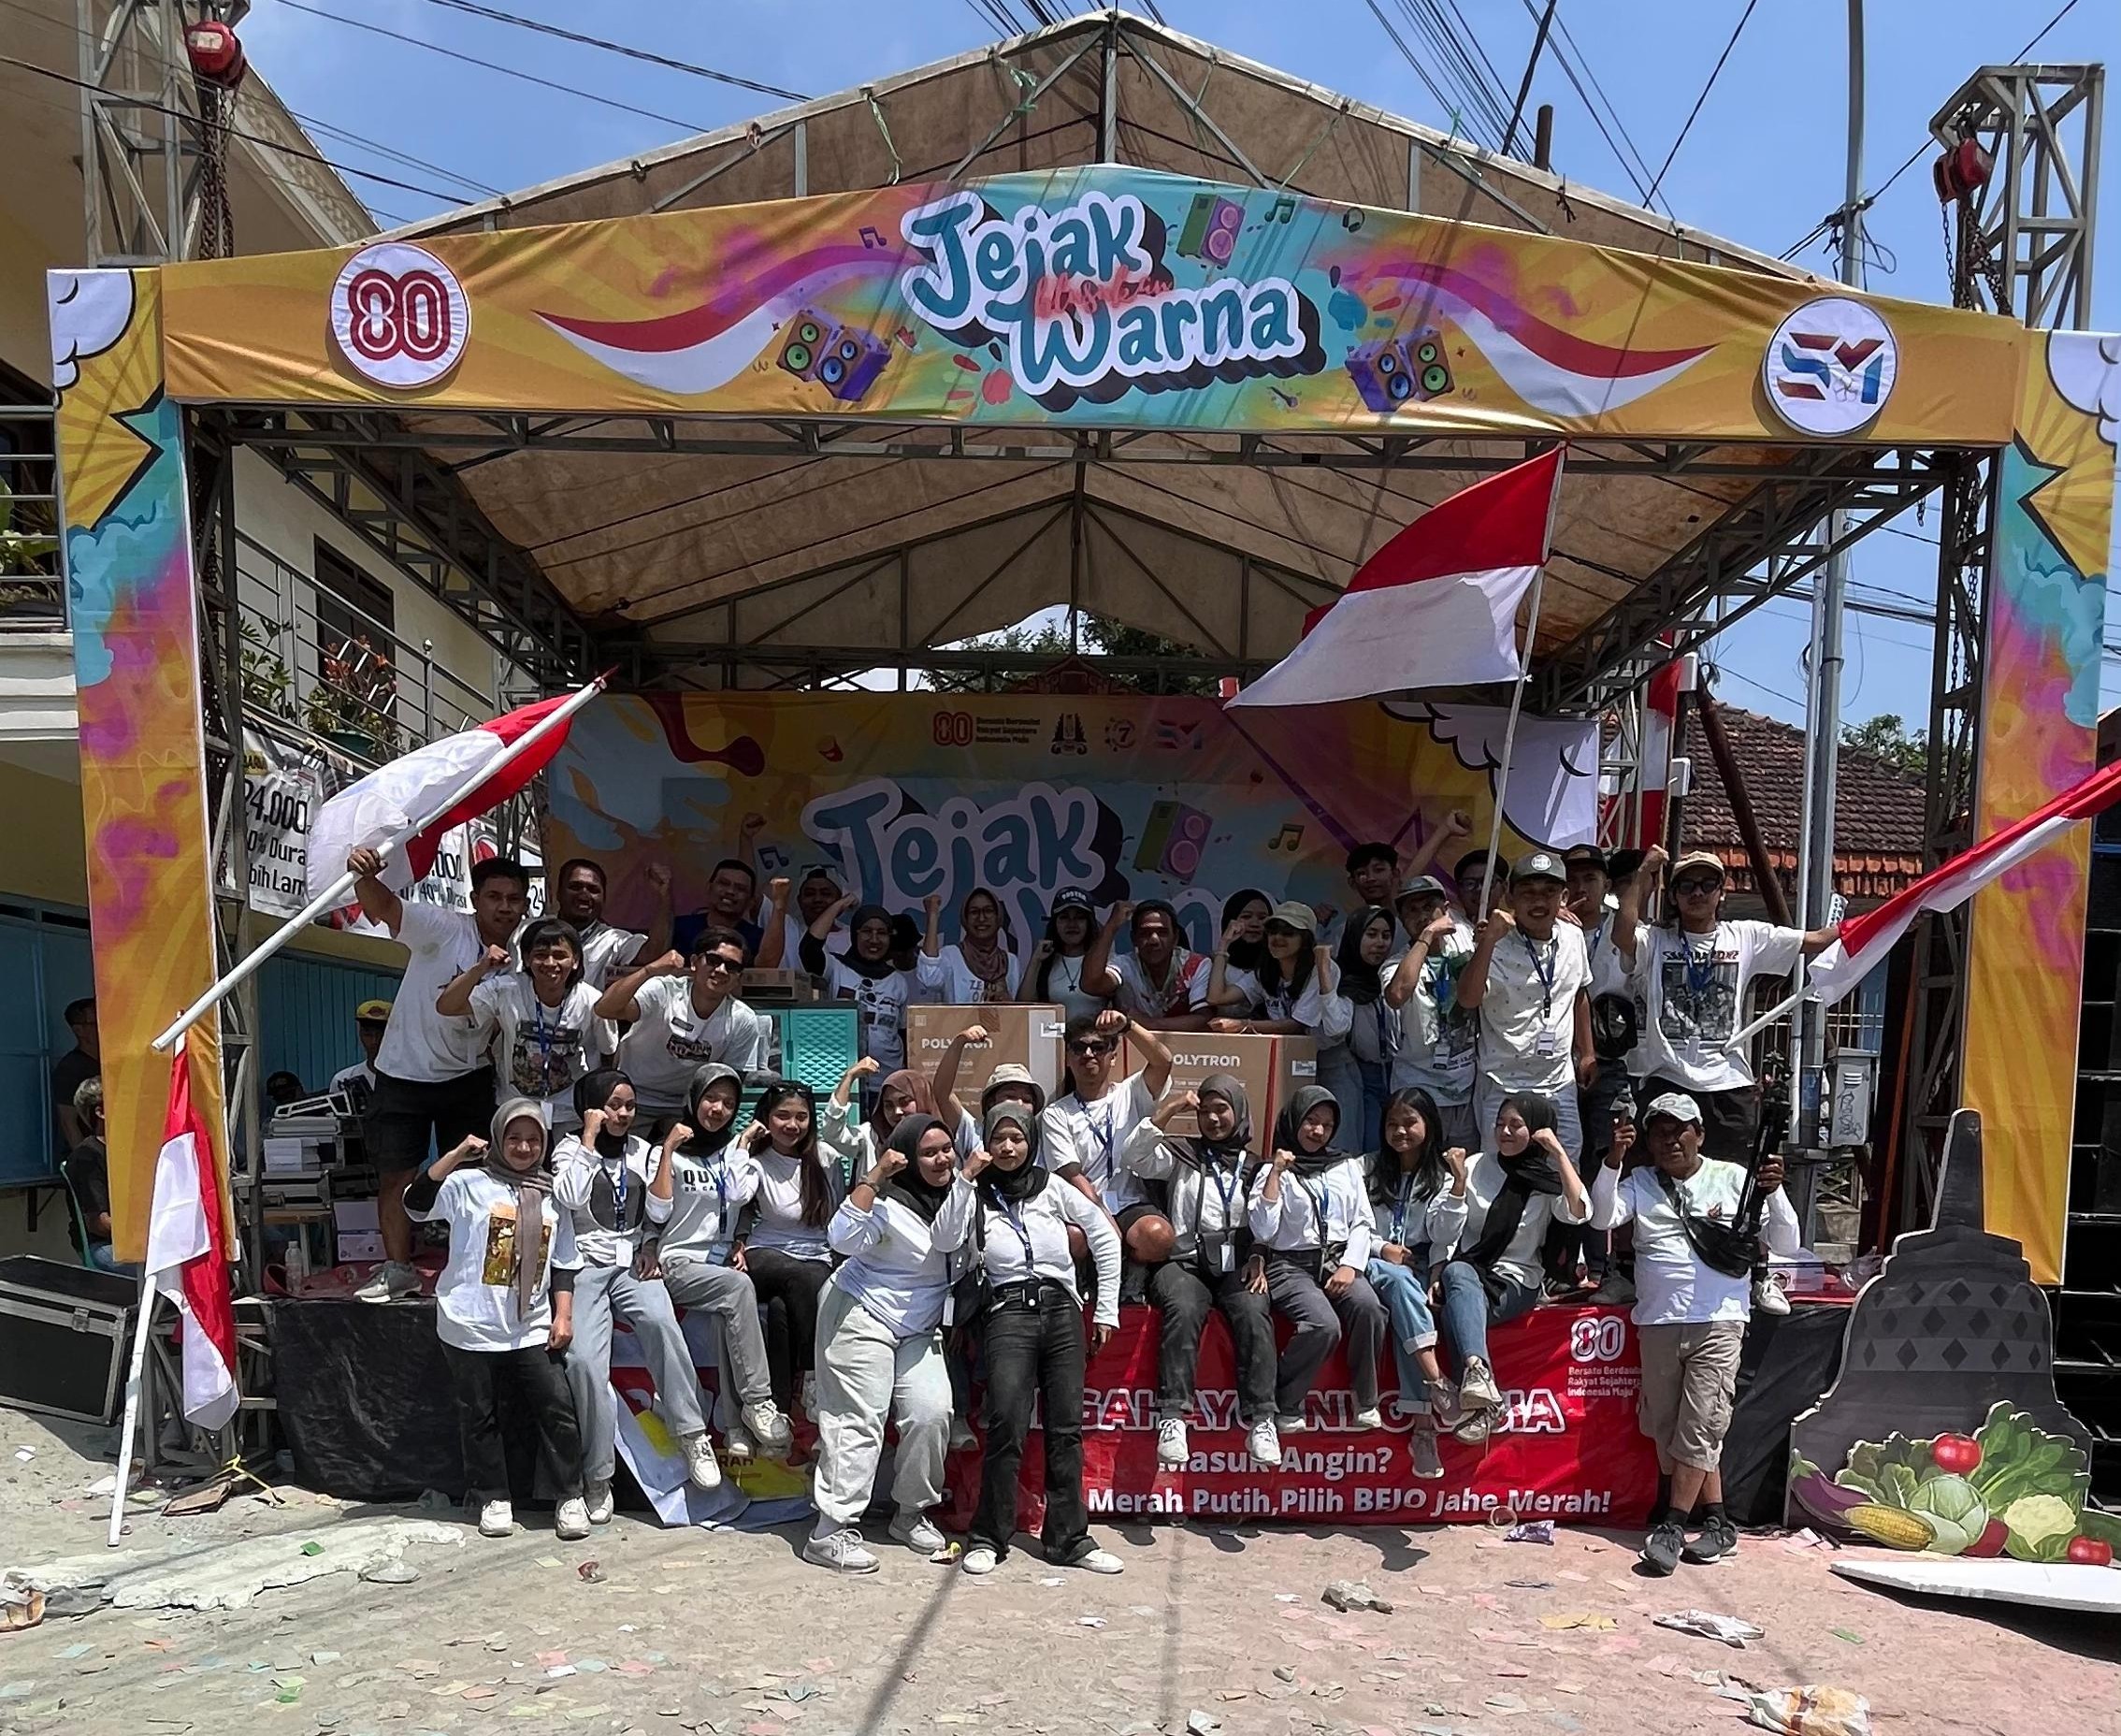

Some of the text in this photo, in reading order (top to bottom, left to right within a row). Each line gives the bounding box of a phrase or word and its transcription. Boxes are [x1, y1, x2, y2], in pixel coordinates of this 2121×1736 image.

[905, 195, 1148, 324] Jejak
[348, 269, 452, 362] 80
[1017, 282, 1300, 382] Warna
[933, 711, 973, 747] 80
[247, 831, 306, 866] 0% Dura
[249, 863, 269, 889] bih
[921, 1037, 993, 1049] POLYON
[1173, 1053, 1241, 1067] OLYTRON
[1569, 1315, 1625, 1363] 80
[1567, 1377, 1597, 1387] Rakyat
[1568, 1367, 1602, 1376] Bersatu
[1567, 1387, 1634, 1397] Indonesia Maju
[1279, 1445, 1393, 1481] Angin?
[1088, 1487, 1184, 1512] Merah
[1353, 1486, 1426, 1512] BEJO
[1508, 1488, 1611, 1513] Merah!
